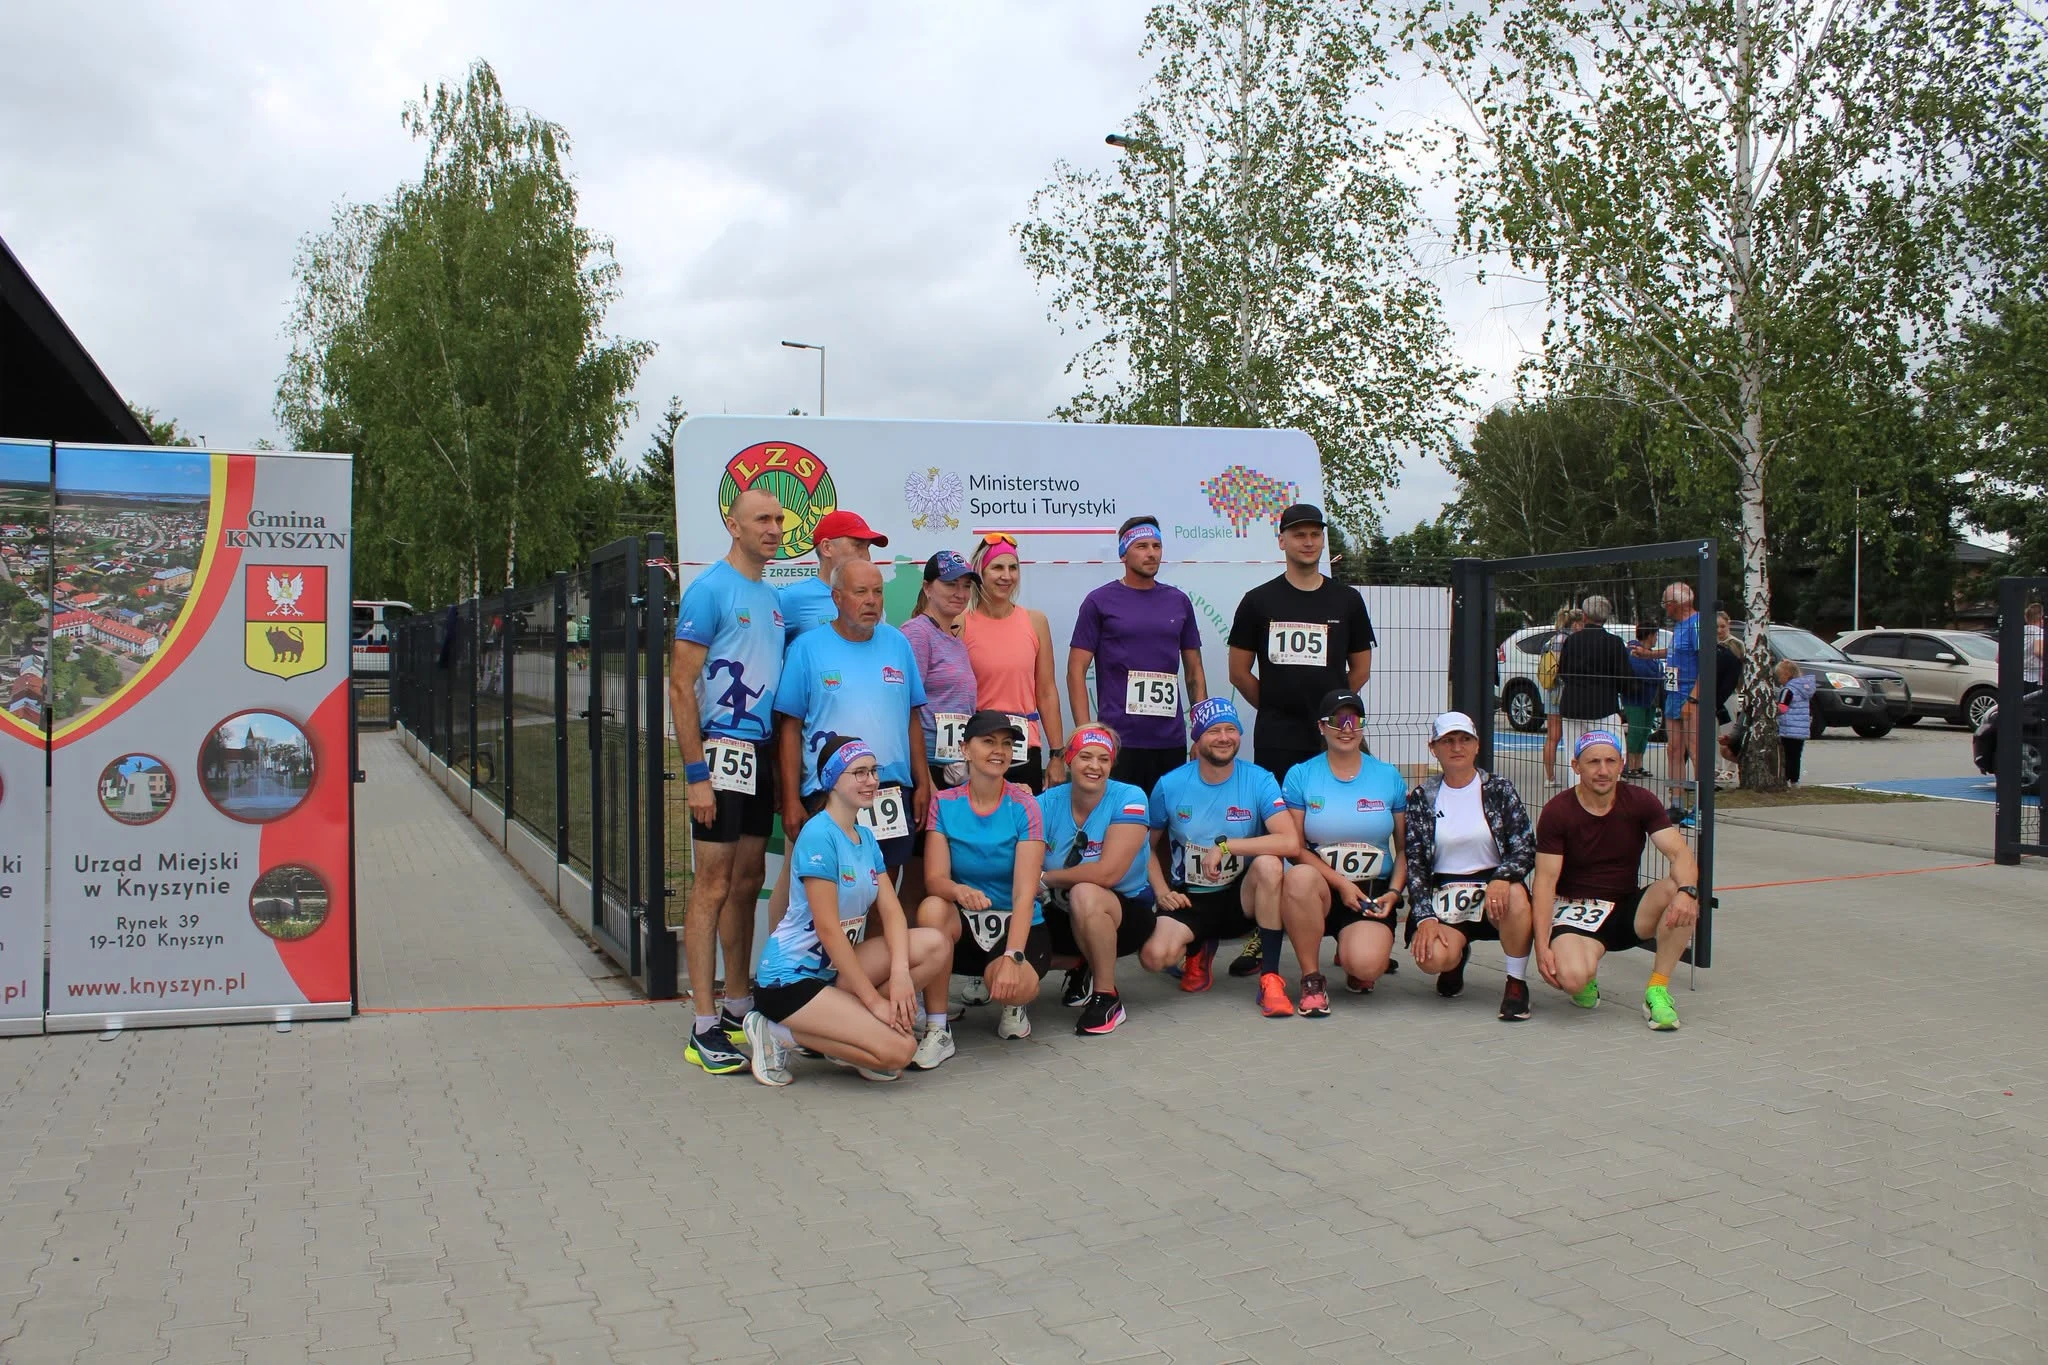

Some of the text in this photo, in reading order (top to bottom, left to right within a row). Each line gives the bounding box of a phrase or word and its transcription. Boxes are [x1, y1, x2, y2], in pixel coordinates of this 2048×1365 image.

[734, 448, 817, 482] LZS
[969, 474, 1080, 492] Ministerstwo
[969, 497, 1116, 518] Sportu i Turystyki
[248, 510, 326, 529] Gmina
[225, 530, 347, 550] KNYSZYN
[1175, 525, 1233, 539] Podlaskie
[769, 567, 820, 577] ZRZESZE
[1275, 630, 1323, 654] 105
[1134, 679, 1176, 706] 153
[705, 747, 753, 779] 155
[74, 851, 239, 877] Urząd Miejski
[1191, 854, 1240, 875] 14
[1326, 850, 1379, 874] 167
[84, 876, 231, 901] w Knyszynie
[1439, 889, 1486, 912] 169
[116, 914, 200, 933] Rynek 39
[1554, 905, 1604, 924] 133
[89, 932, 225, 949] 19-120 Knyszyn
[67, 972, 247, 998] www.knyszyn.pl
